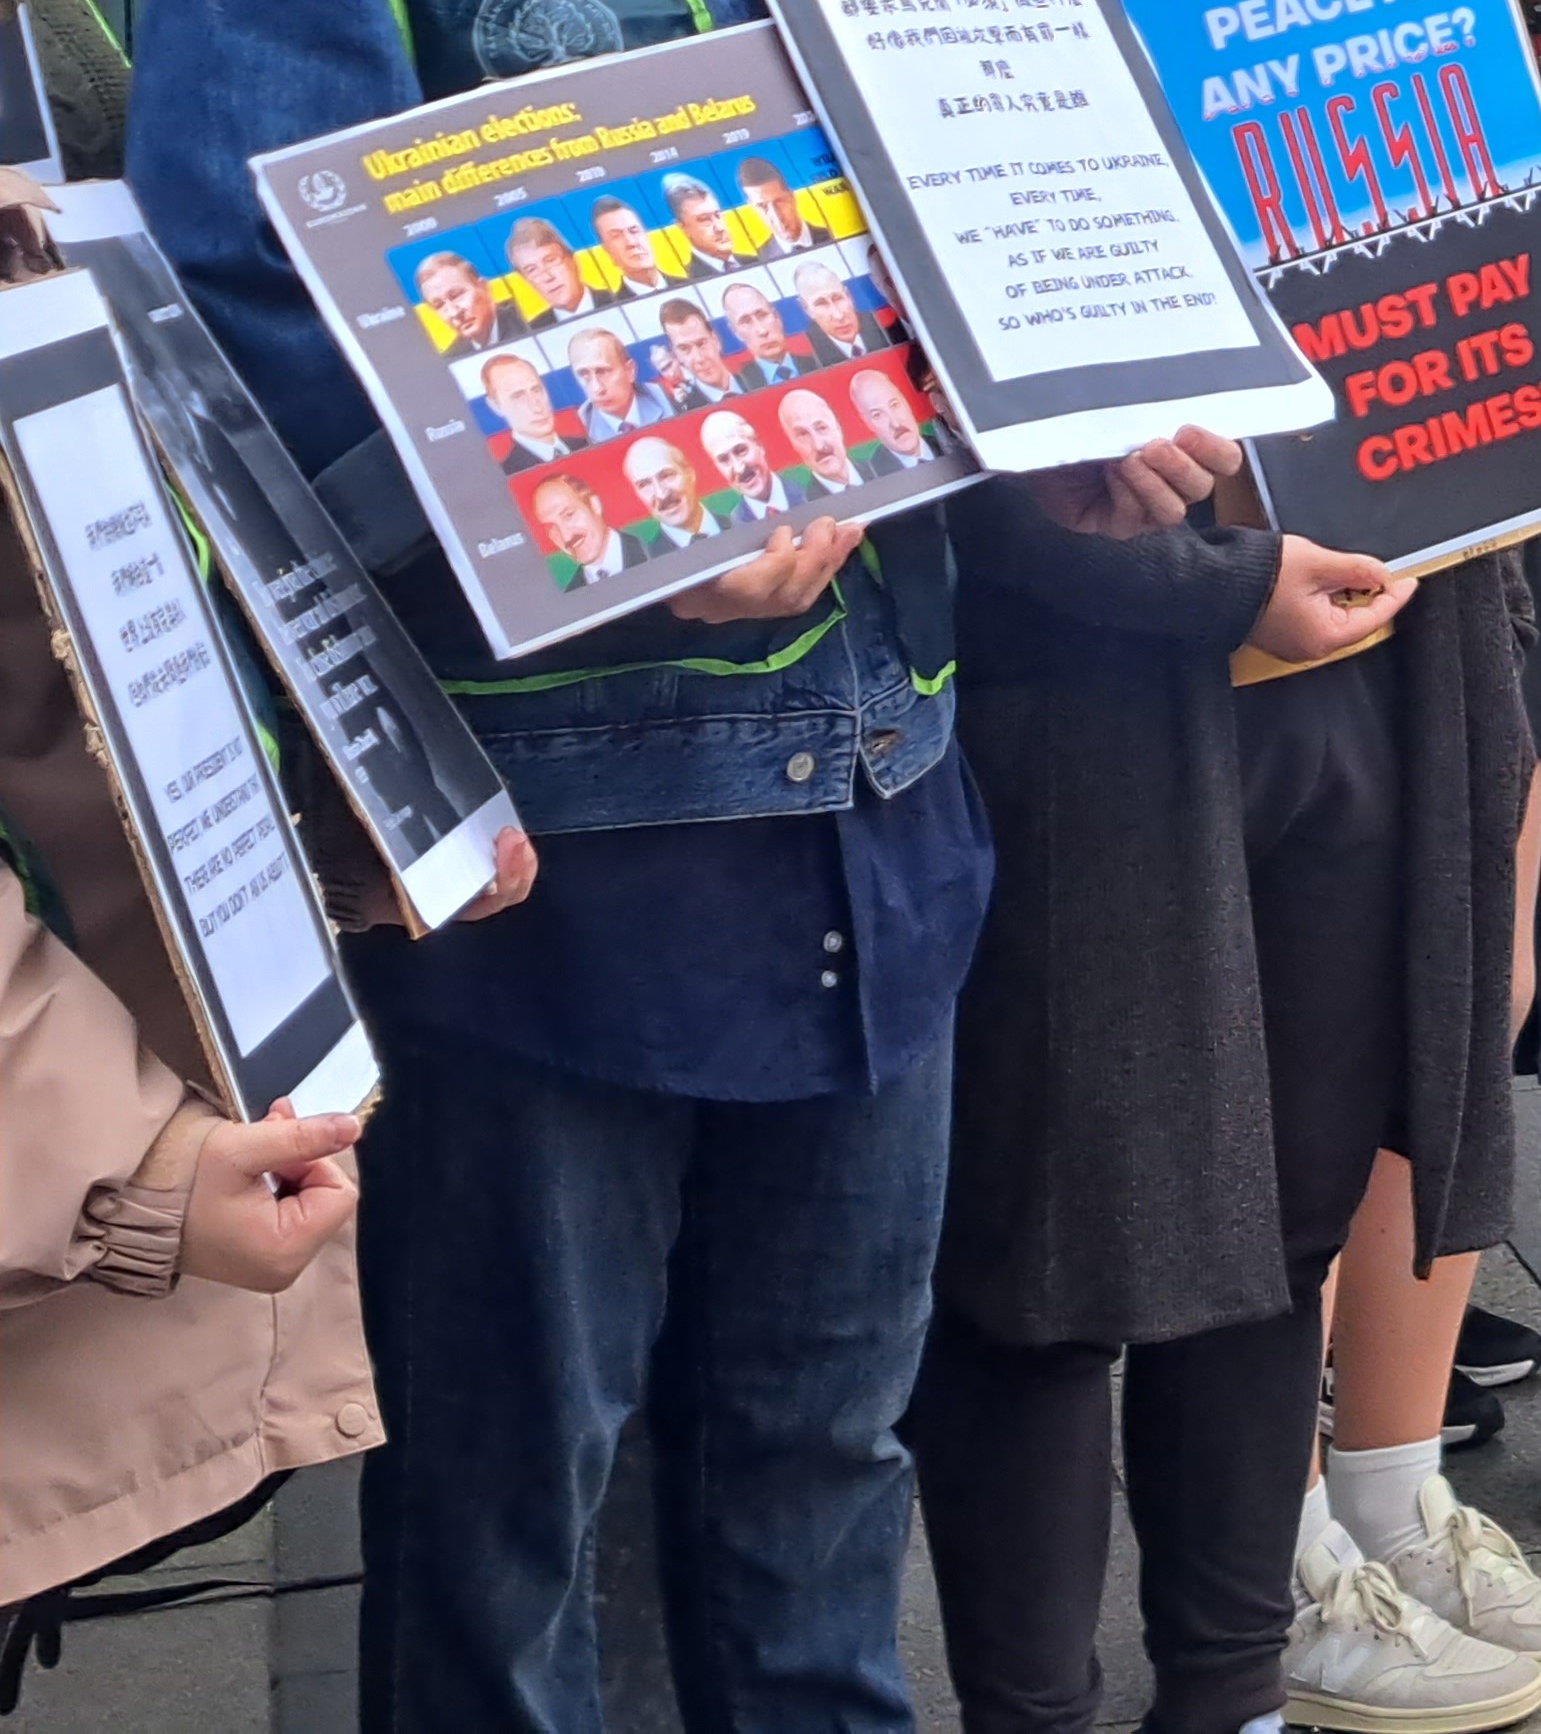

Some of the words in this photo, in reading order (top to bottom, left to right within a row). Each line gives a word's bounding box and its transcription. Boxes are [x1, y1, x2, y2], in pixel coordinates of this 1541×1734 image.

[1202, 53, 1300, 121] ANY
[1312, 6, 1476, 87] PRICE?
[363, 129, 481, 180] Ukrainian
[480, 102, 583, 143] elections:
[721, 128, 750, 145] 2019
[383, 179, 443, 214] main
[442, 146, 554, 194] differences
[550, 134, 602, 161] from
[595, 117, 657, 149] Russia
[655, 105, 694, 135] and
[686, 94, 757, 126] Belarus
[649, 146, 680, 164] 2014
[1231, 63, 1502, 264] RUSSIA
[907, 169, 962, 189] EVERY
[966, 164, 1008, 183] TIME
[1009, 162, 1024, 176] IT
[1028, 160, 1075, 175] COMES
[1076, 157, 1100, 172] TO
[493, 186, 528, 208] 2005
[1009, 189, 1057, 206] EVERY
[954, 228, 982, 245] WE
[1045, 218, 1065, 233] TO
[1069, 217, 1091, 232] DO
[1007, 253, 1029, 268] AS
[1031, 250, 1048, 264] IF
[1050, 247, 1076, 261] WE
[1078, 245, 1107, 260] ARE
[1109, 239, 1160, 258] GUILTY
[1005, 283, 1028, 299] OF
[1031, 275, 1080, 294] BEING
[1082, 272, 1132, 290] UNDER
[998, 316, 1021, 331] SO
[1080, 301, 1127, 319] GUILTY
[1130, 300, 1149, 315] IN
[1149, 295, 1182, 312] THE
[1291, 282, 1438, 362] MUST
[1446, 252, 1531, 317] PAY
[1345, 349, 1455, 417] FOR
[1456, 322, 1535, 382] ITS
[477, 532, 525, 559] Belarus
